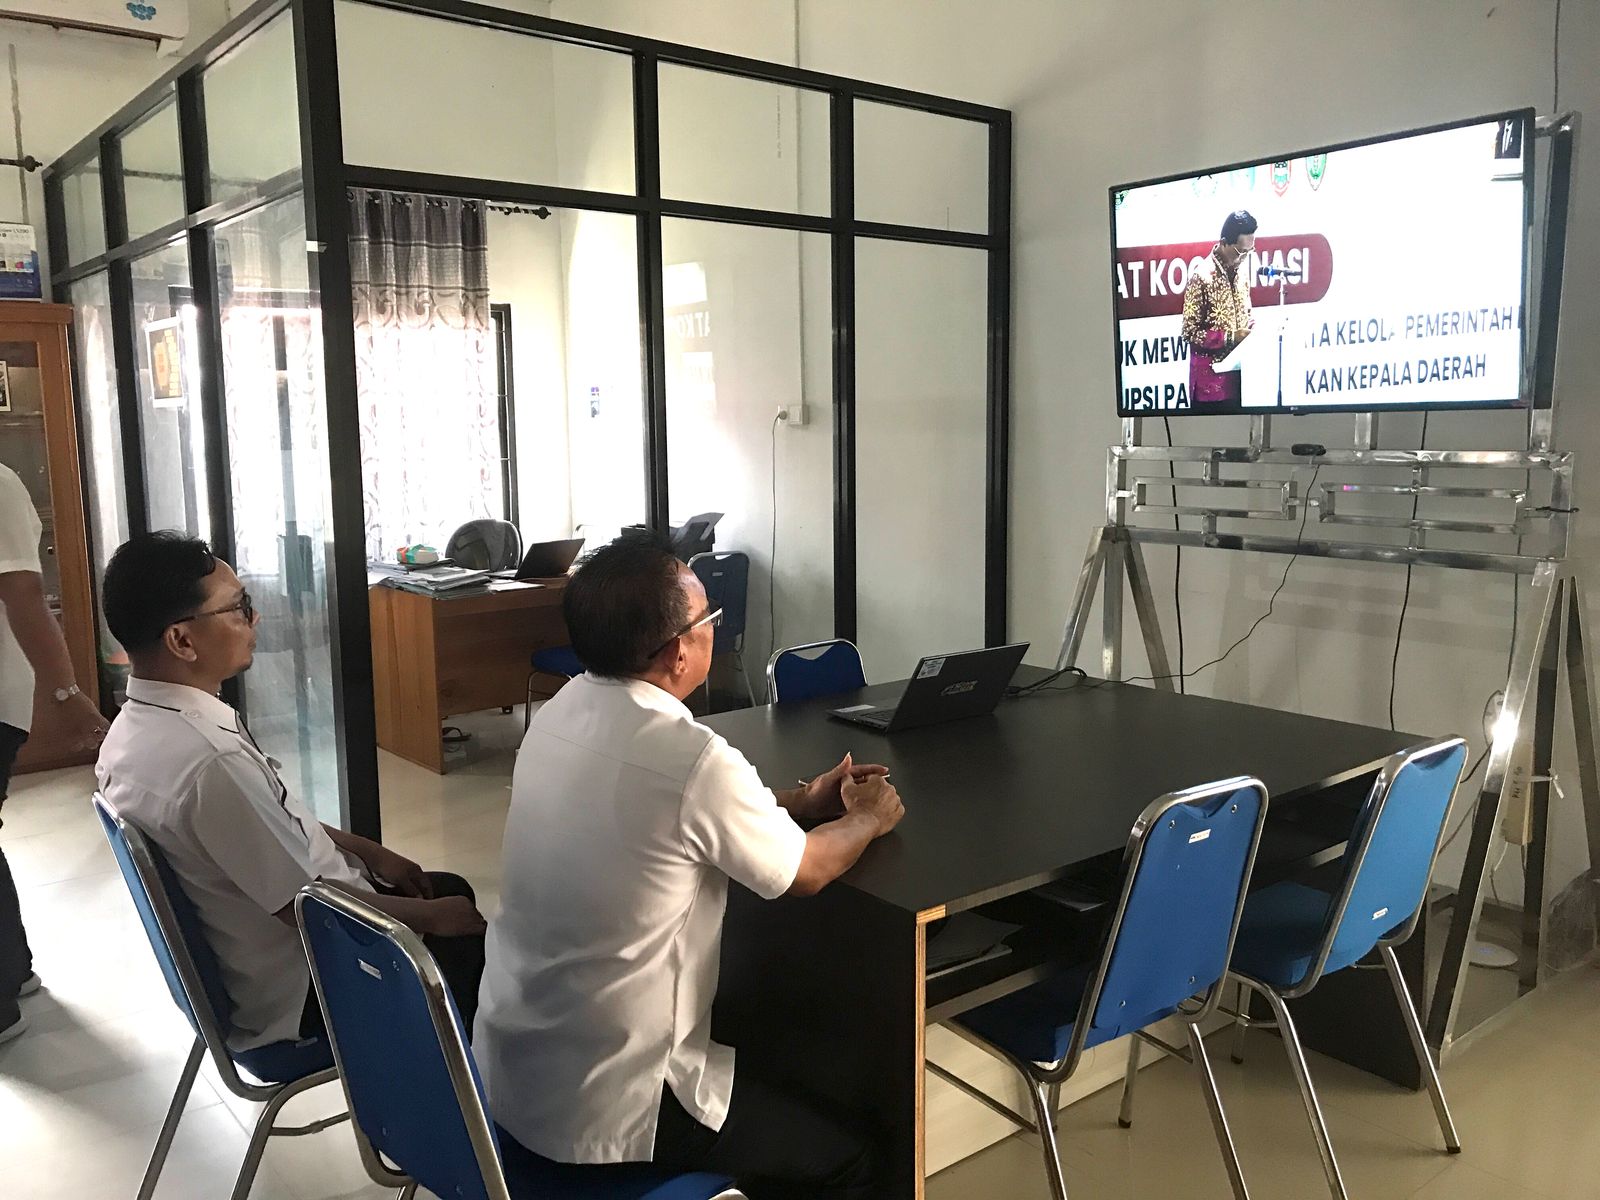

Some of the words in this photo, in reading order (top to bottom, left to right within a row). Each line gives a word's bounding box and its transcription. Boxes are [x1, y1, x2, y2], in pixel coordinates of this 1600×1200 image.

[1120, 340, 1138, 366] K
[1405, 305, 1513, 340] PEMERINTAH
[1305, 366, 1343, 395] KAN
[1347, 360, 1412, 391] KEPALA
[1417, 353, 1486, 384] DAERAH
